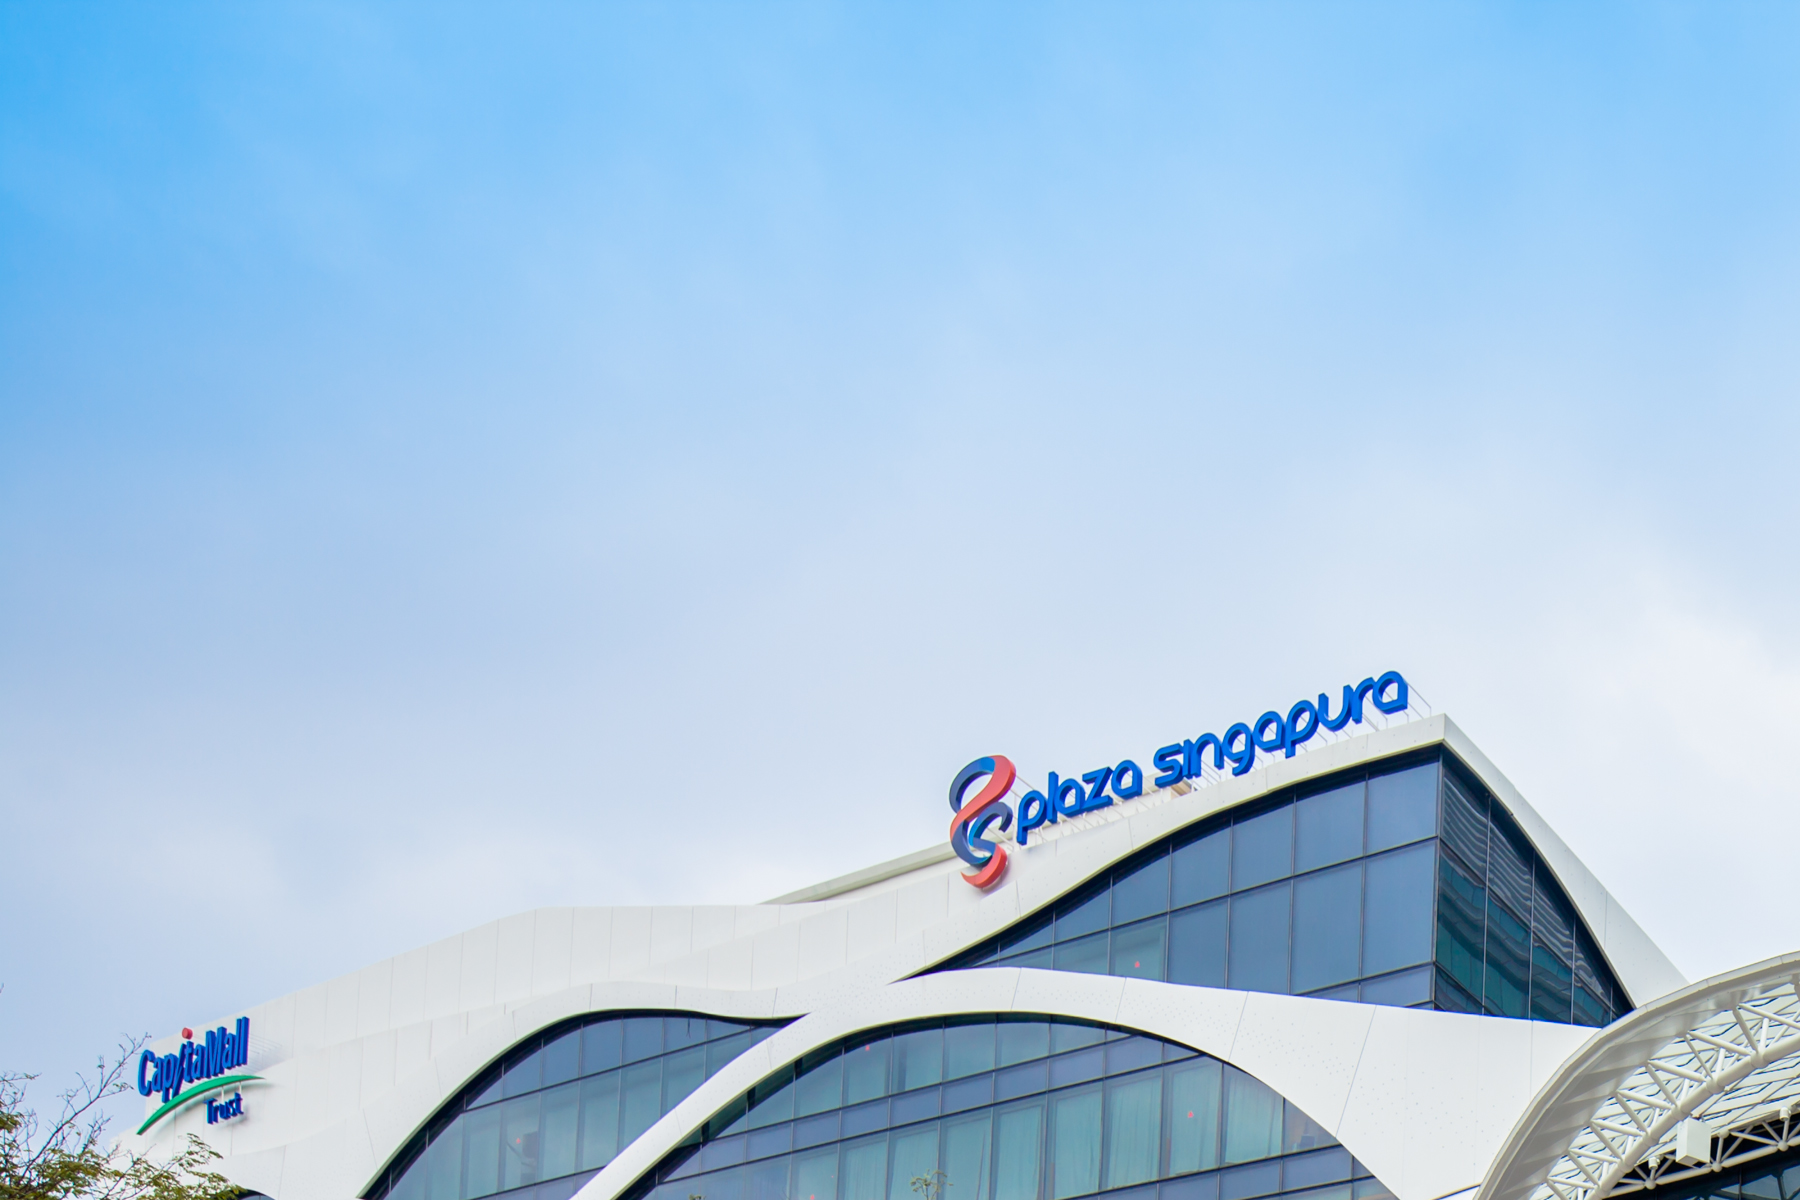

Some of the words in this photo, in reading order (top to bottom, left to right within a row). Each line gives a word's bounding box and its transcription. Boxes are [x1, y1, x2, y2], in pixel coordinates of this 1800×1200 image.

[1016, 759, 1143, 845] plaza
[1153, 670, 1408, 788] singapura
[138, 1016, 250, 1103] CapitaMall
[204, 1092, 243, 1125] Trust
